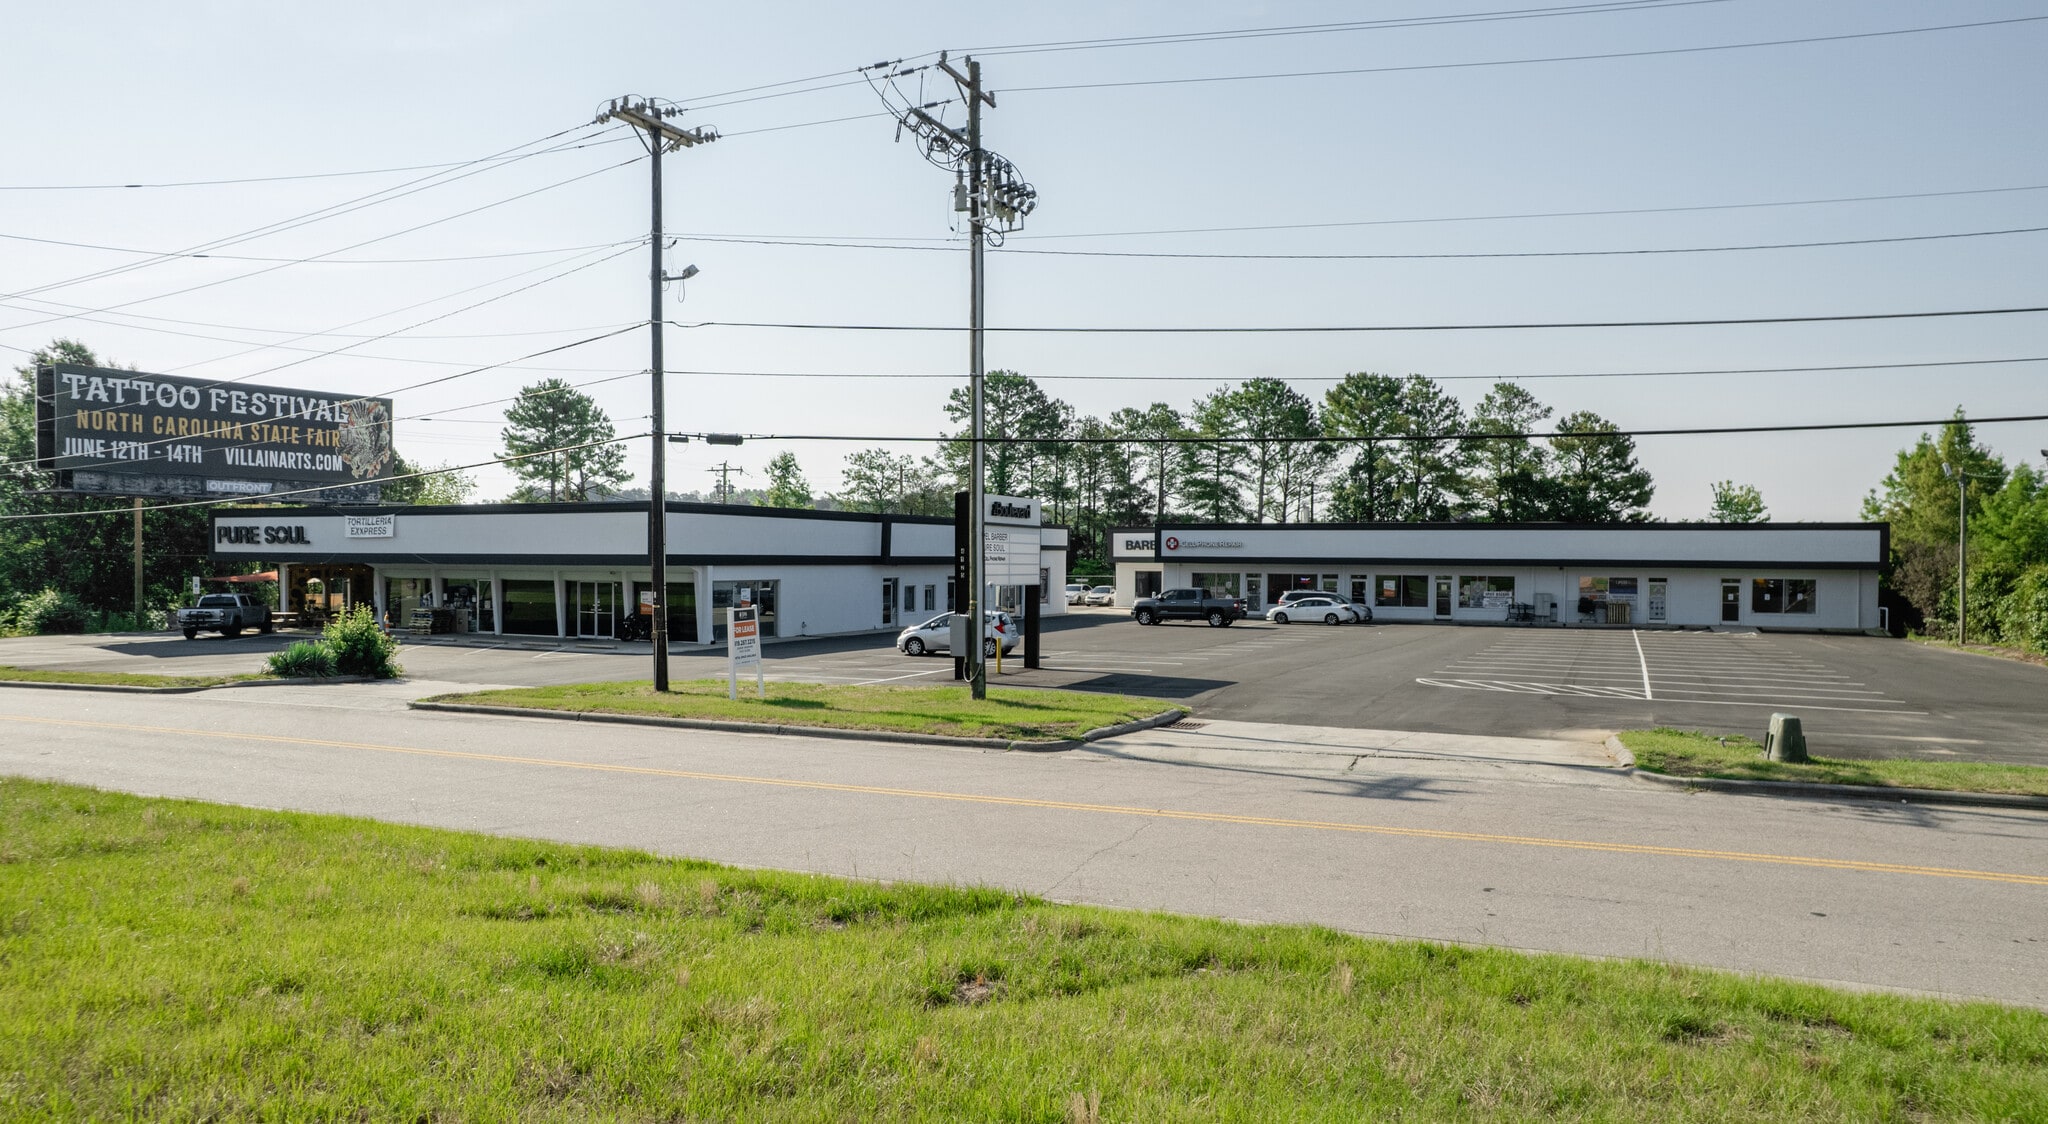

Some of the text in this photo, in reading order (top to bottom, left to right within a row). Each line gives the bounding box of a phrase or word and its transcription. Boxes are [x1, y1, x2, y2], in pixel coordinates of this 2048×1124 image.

[61, 373, 350, 424] TATTOO FESTIVAL
[77, 409, 341, 448] NORTH CAROLINA STATE FAIR
[61, 437, 106, 459] JUNE
[110, 440, 149, 461] 12TH
[165, 443, 203, 464] 14TH
[224, 448, 343, 472] VILLAINARTS.COM
[209, 482, 269, 492] OUTFRONT
[347, 517, 392, 526] TORTILLERIA
[216, 525, 311, 545] PURE SOUL
[350, 527, 387, 536] EXXPRESS
[991, 532, 1008, 541] BARBER
[993, 543, 1005, 552] SOUL
[742, 624, 755, 633] LEASE
